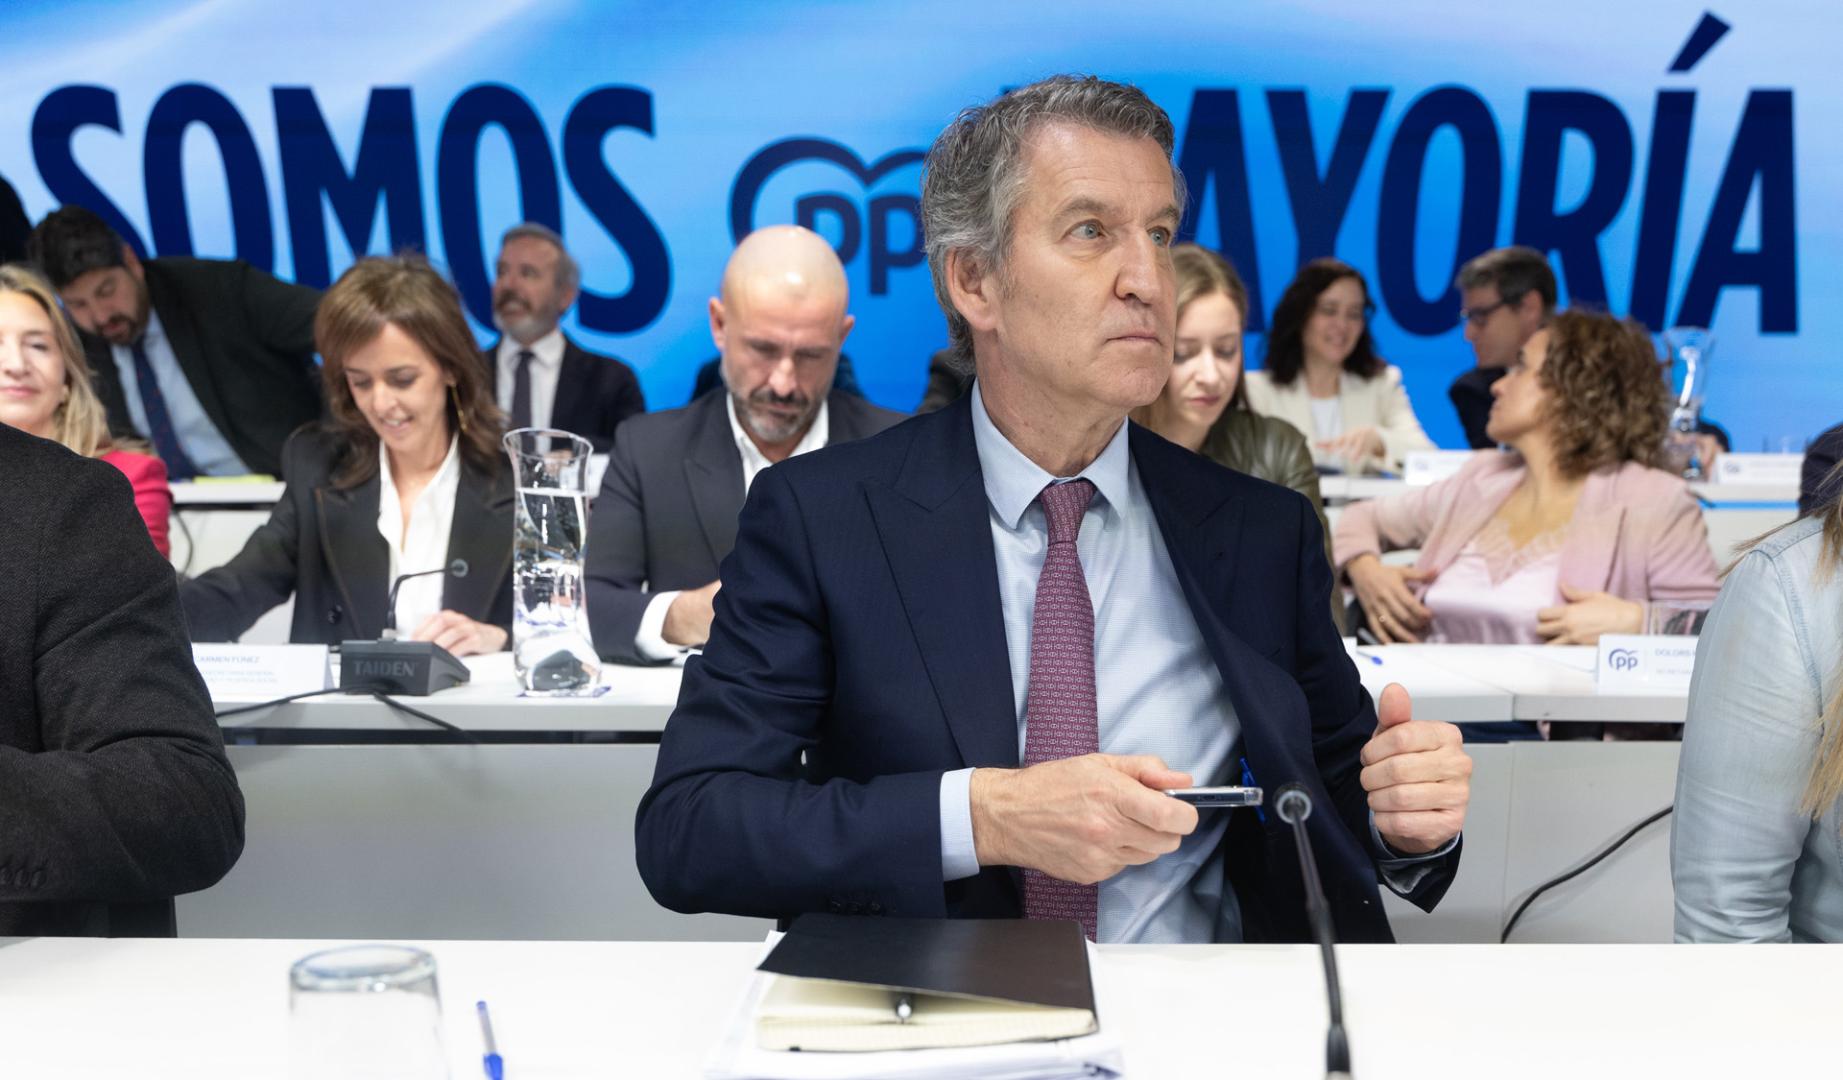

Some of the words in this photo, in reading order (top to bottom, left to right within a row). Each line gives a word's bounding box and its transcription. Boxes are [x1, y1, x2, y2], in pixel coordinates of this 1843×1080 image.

[30, 82, 671, 334] SOMOS
[1001, 12, 1799, 337] AYORÍA
[353, 661, 415, 677] TAIDEN
